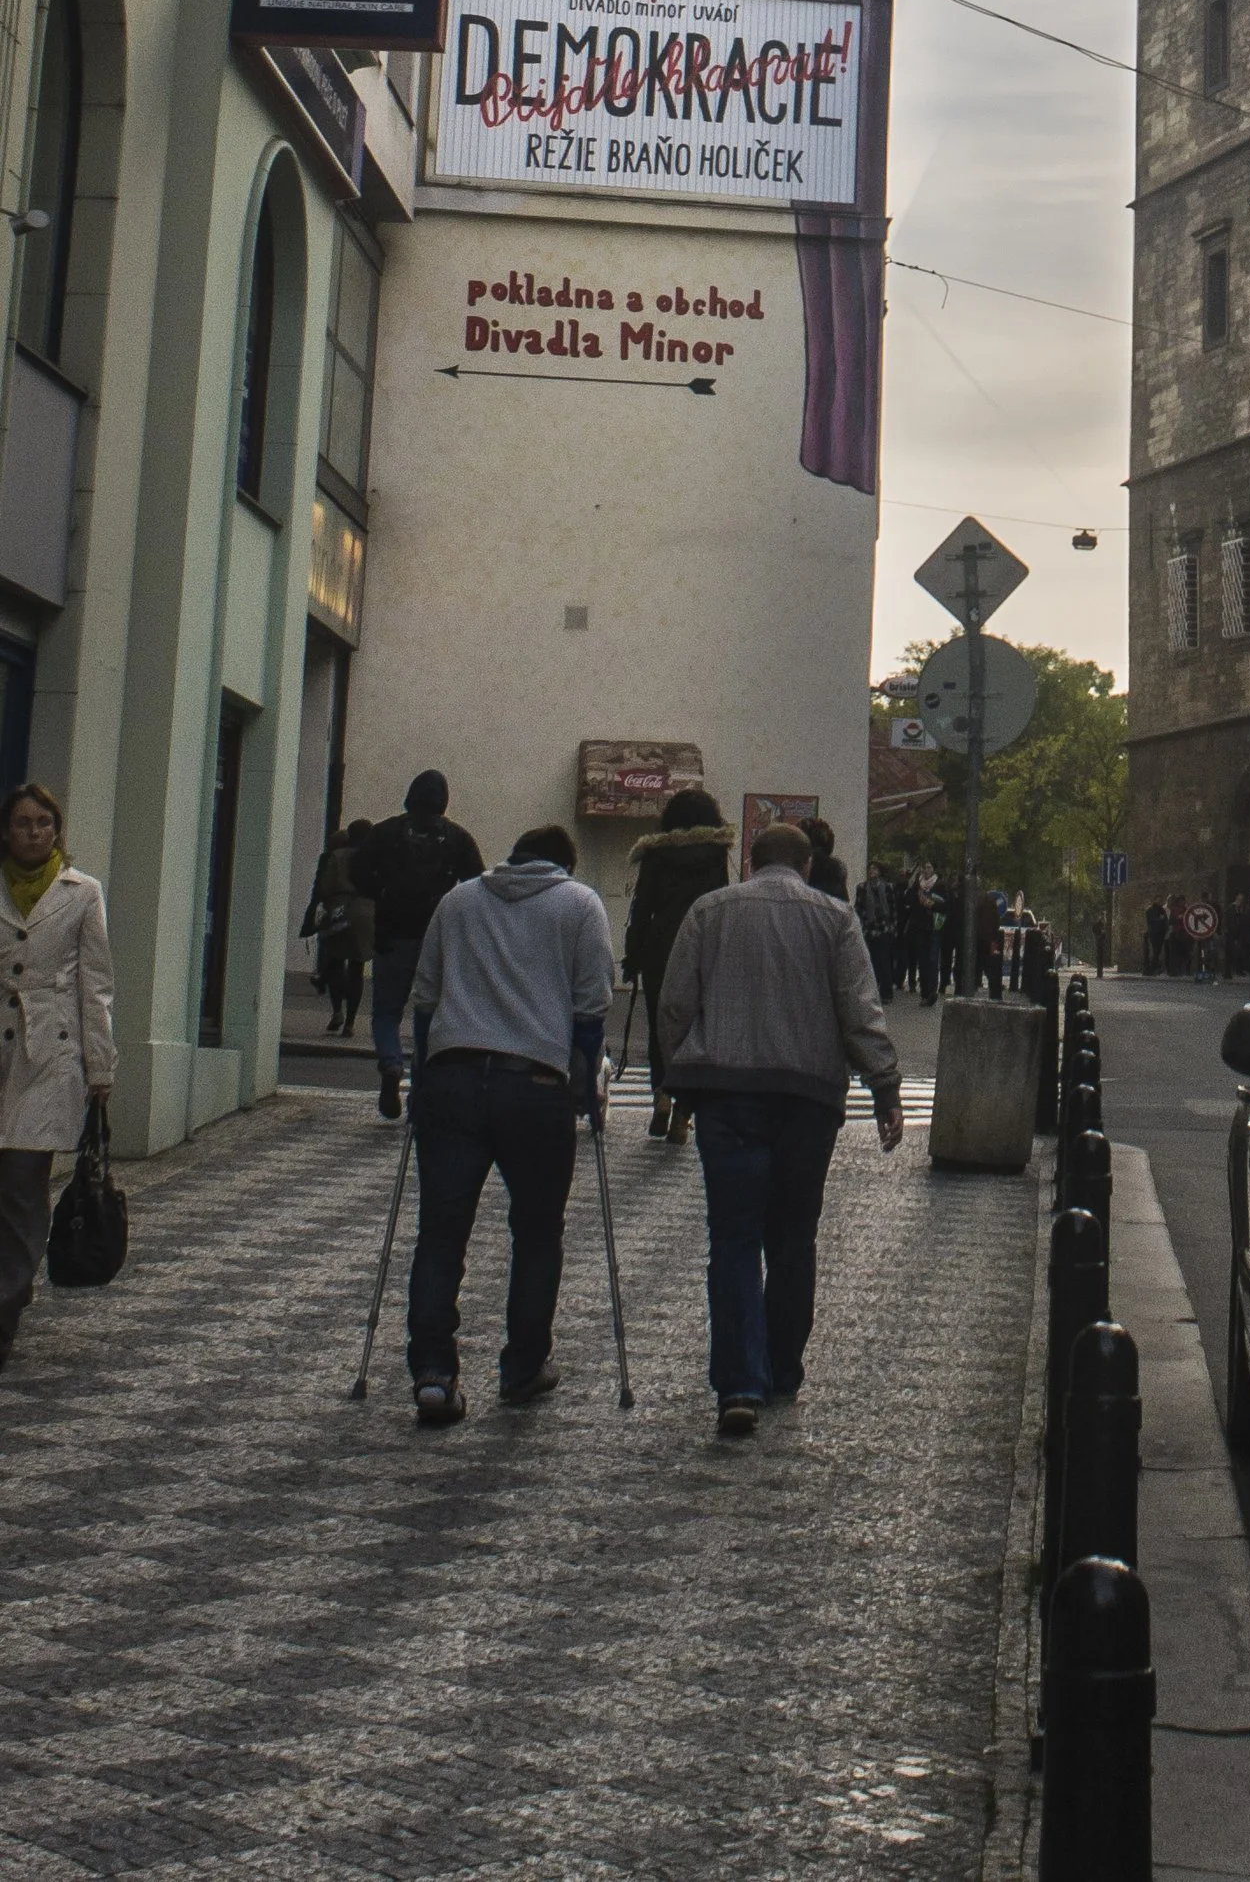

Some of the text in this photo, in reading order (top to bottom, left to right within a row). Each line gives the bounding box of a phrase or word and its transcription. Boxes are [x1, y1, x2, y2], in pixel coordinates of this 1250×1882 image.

[693, 3, 741, 23] UVÁDÍ
[455, 13, 843, 128] DEMOKRACIE
[526, 128, 806, 183] REŽIE BRAŇO HOLIČEK
[467, 270, 765, 320] pokladna a obchod
[464, 315, 735, 366] Divadla Minor
